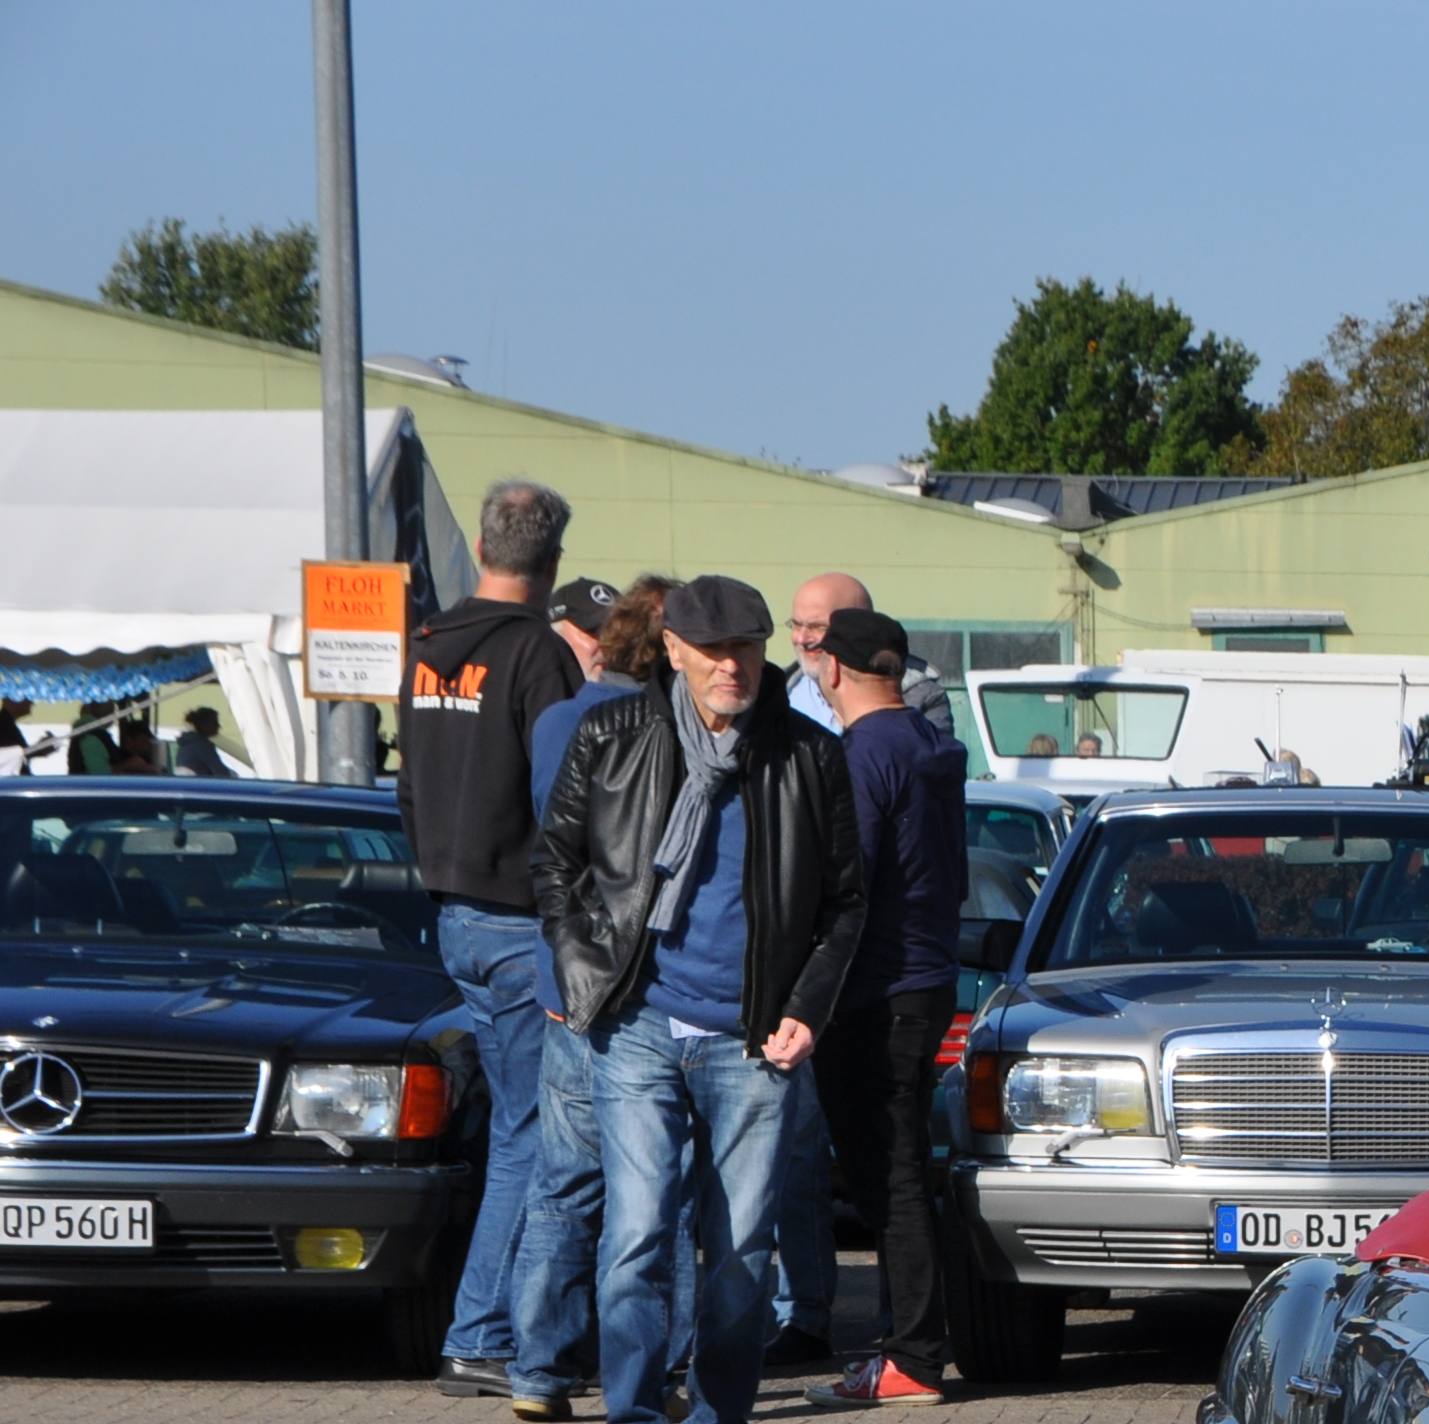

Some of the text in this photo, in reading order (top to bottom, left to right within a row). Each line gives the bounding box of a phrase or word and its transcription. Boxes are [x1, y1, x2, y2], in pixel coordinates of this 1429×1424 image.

[325, 575, 382, 594] FLOH
[322, 600, 386, 616] MARKT
[3, 1205, 46, 1238] QP
[1222, 1232, 1232, 1244] D
[1241, 1212, 1281, 1246] OD
